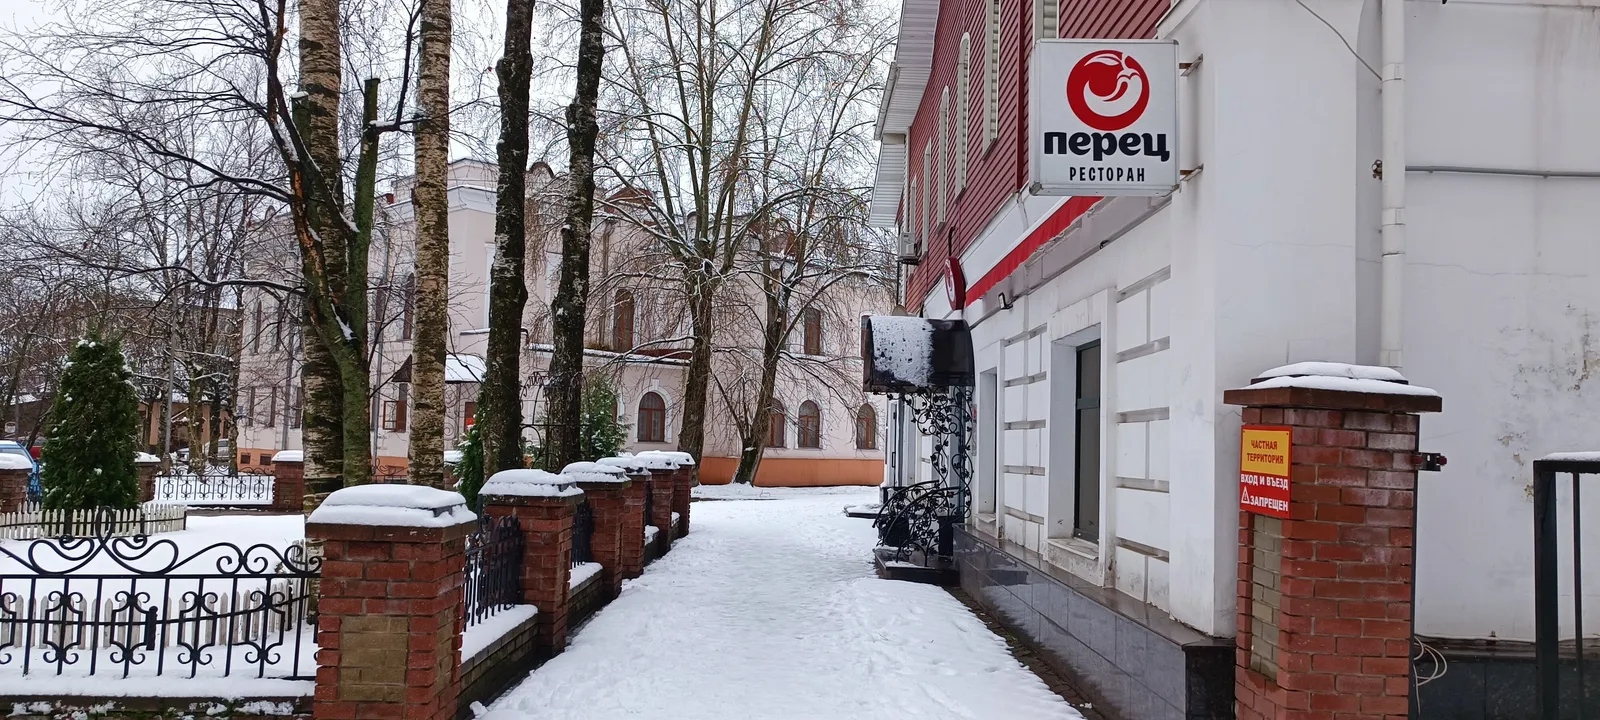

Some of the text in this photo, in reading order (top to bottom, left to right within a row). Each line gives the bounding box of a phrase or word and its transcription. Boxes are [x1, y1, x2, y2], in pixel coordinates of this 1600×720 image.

[1044, 131, 1170, 162] перец
[1069, 166, 1145, 182] РЕСТОРАН
[1251, 440, 1277, 450] ЧАСТНАЯ
[1247, 453, 1284, 464] ТЕРРИТОРИЯ
[1240, 474, 1289, 491] ВХОД И ВЪЕЗД
[1250, 495, 1289, 512] ЗАПРЕЩЕН
